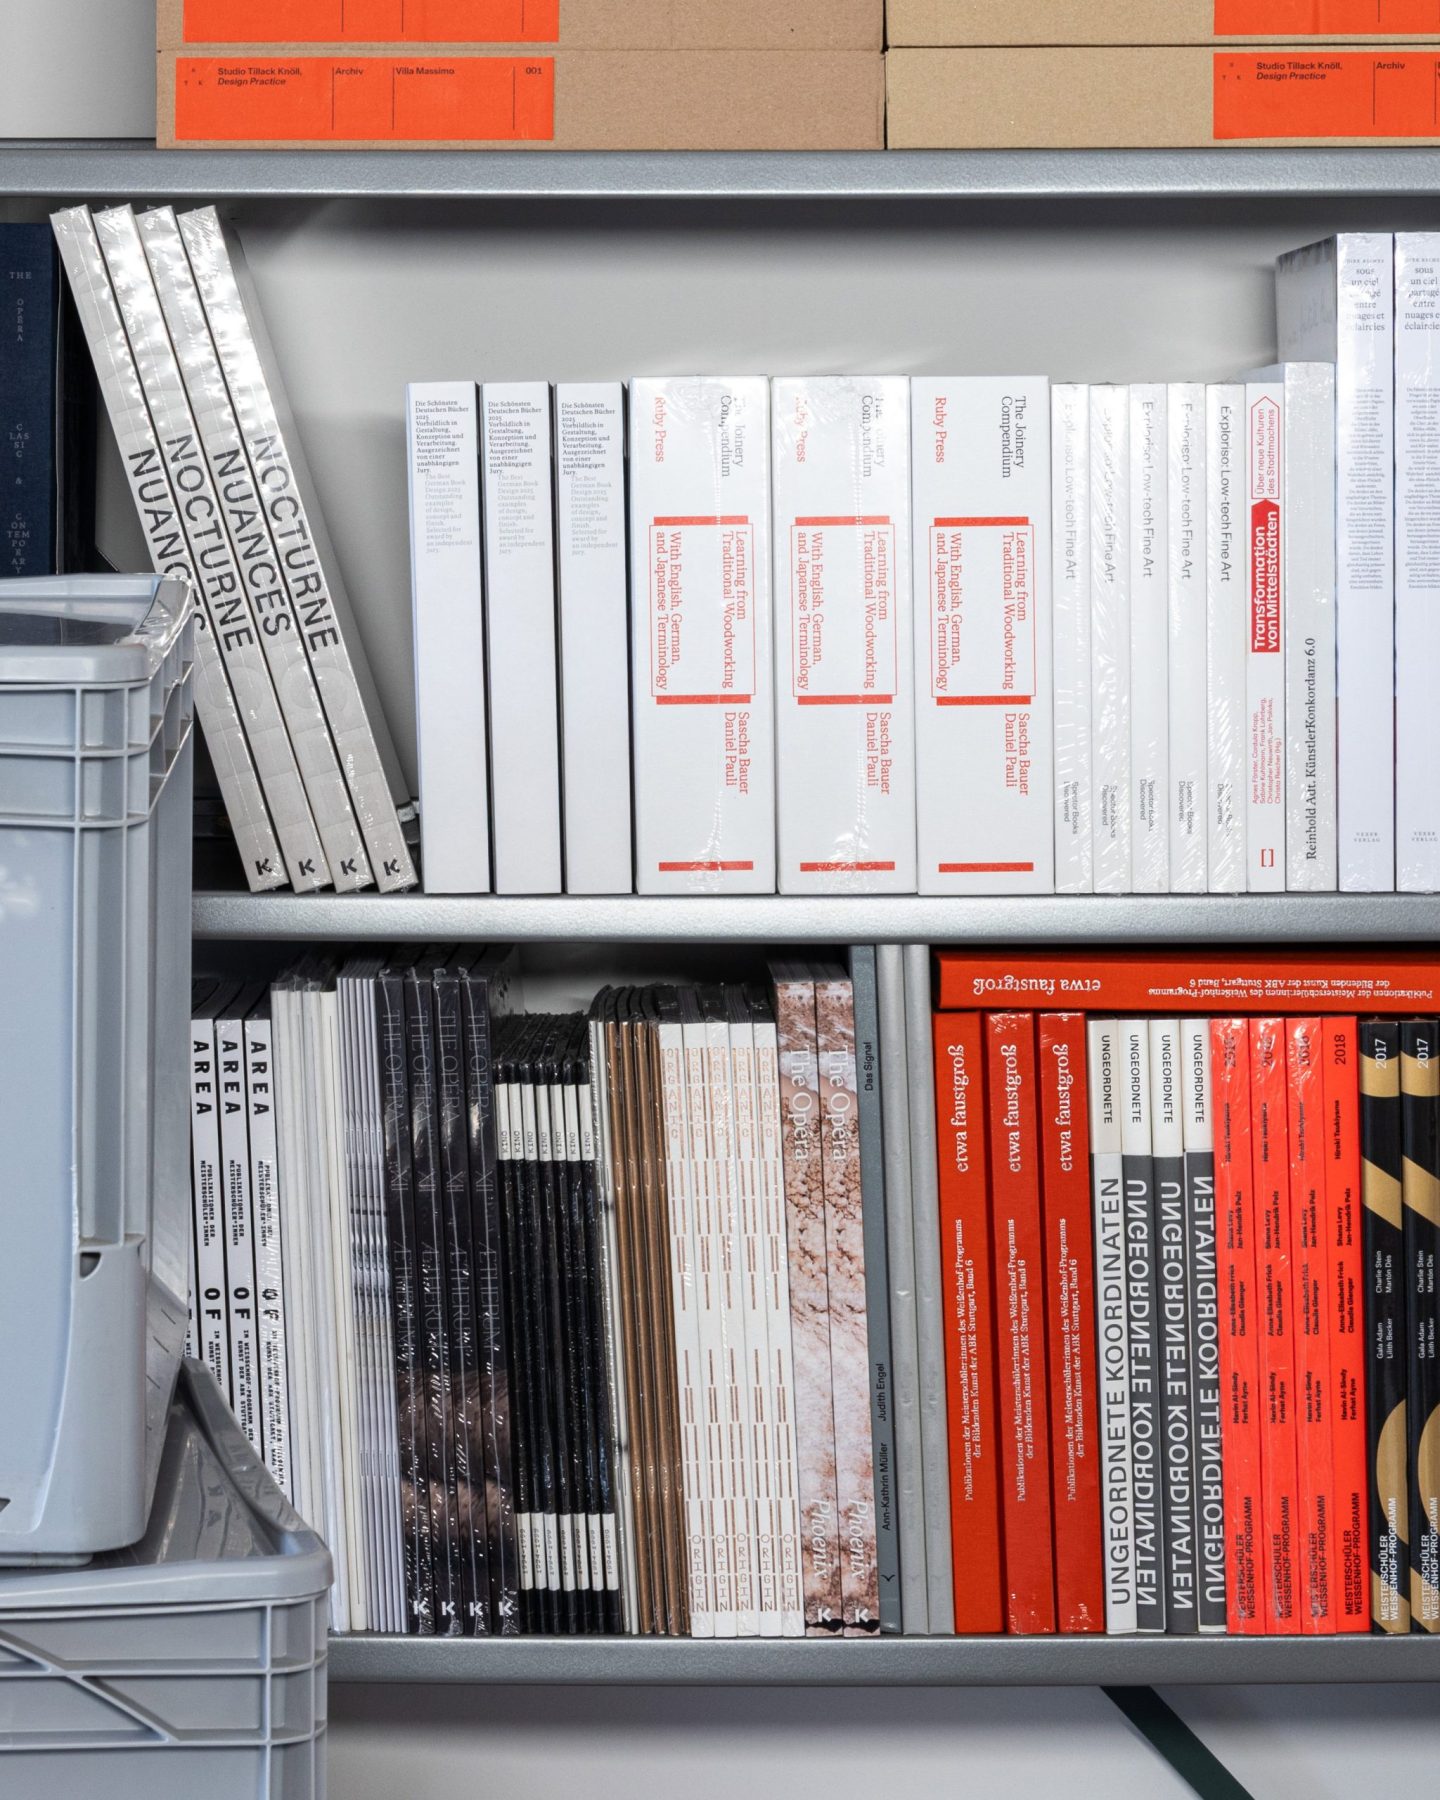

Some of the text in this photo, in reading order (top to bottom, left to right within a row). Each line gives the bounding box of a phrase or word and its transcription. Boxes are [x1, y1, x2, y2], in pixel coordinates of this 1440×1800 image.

[218, 77, 286, 87] Design Practice
[335, 67, 363, 75] Archiv
[396, 67, 414, 75] Villa
[1257, 62, 1285, 70] Studio
[1257, 72, 1326, 81] Design Practice
[934, 397, 947, 463] Ruby Press
[999, 396, 1012, 478] Compendium
[1012, 396, 1026, 468] The Joinery
[1256, 409, 1264, 446] Kulturen
[1267, 410, 1275, 494] des Stadtmachens
[1219, 406, 1232, 581] Exploriso: Low-tech Fine Art
[1255, 473, 1265, 495] Über
[166, 434, 254, 652] NOCTURNE
[213, 449, 291, 636] NUANCES
[252, 435, 339, 652] NOCTURNE
[1015, 531, 1028, 621] Learning from
[1266, 512, 1277, 649] von Mittelstädten
[936, 533, 949, 691] and Japanese Terminology
[949, 533, 961, 665] With English, German,
[1003, 534, 1015, 689] Traditional Woodworking
[1254, 527, 1265, 649] Transformation
[1305, 638, 1315, 656] 6.0
[1005, 714, 1018, 787] Daniel Pauli
[1018, 713, 1030, 796] Sascha Bauer
[1305, 659, 1316, 777] KünstlerKonkordanz
[1306, 808, 1316, 859] Reinhold
[973, 975, 1100, 995] etwa faustgroß
[468, 1014, 486, 1051] THE
[863, 1042, 874, 1091] Das Signal
[1334, 1035, 1346, 1064] 2018
[1374, 1038, 1386, 1069] 2017
[1417, 1038, 1428, 1069] 2017
[194, 1041, 212, 1115] AREA
[222, 1040, 241, 1114] AREA
[251, 1041, 270, 1115] AREA
[790, 1044, 813, 1161] The Opéra
[828, 1045, 850, 1162] The Opéra
[948, 1045, 969, 1172] etwa faustgroß
[1001, 1045, 1021, 1172] etwa faustgroß
[1052, 1044, 1073, 1171] etwa faustgroß
[1102, 1035, 1112, 1123] UNGEORDNETE
[1130, 1035, 1141, 1123] UNGEORDNETE
[1162, 1035, 1173, 1123] UNGEORDNETE
[1193, 1035, 1204, 1123] UNGEORDNETE
[476, 1170, 494, 1192] XII
[205, 1288, 221, 1320] OF
[234, 1287, 250, 1319] OF
[876, 1364, 886, 1421] Judith Engel
[1100, 1178, 1130, 1605] UNGEORDNETE KOORDINATEN
[879, 1443, 890, 1530] Ann-Kathrin Müller
[692, 1534, 704, 1611] ORIGIN
[716, 1535, 728, 1610] ORIGIN
[737, 1532, 749, 1610] ORIGIN
[761, 1534, 773, 1610] ORIGIN
[784, 1534, 795, 1610] ORIGIN
[810, 1499, 831, 1578] Phoenix
[848, 1499, 868, 1578] Phoenix
[1246, 1496, 1255, 1620] WEISSENHOF-PROGRAMM
[1283, 1496, 1292, 1618] WEISSENHOF-PROGRAMM
[1318, 1496, 1328, 1617] WEISSENHOF-PROGRAMM
[1344, 1530, 1352, 1616] MEISTERSCHÜLER
[1352, 1492, 1362, 1615] WEISSENHOF-PROGRAMM
[1379, 1534, 1388, 1621] MEISTERSCHÜLER
[1389, 1497, 1398, 1620] WEISSENHOF-PROGRAMM
[1420, 1534, 1430, 1621] MEISTERSCHÜLER
[1430, 1497, 1439, 1620] WEISSENHOF-PROGRAMM
